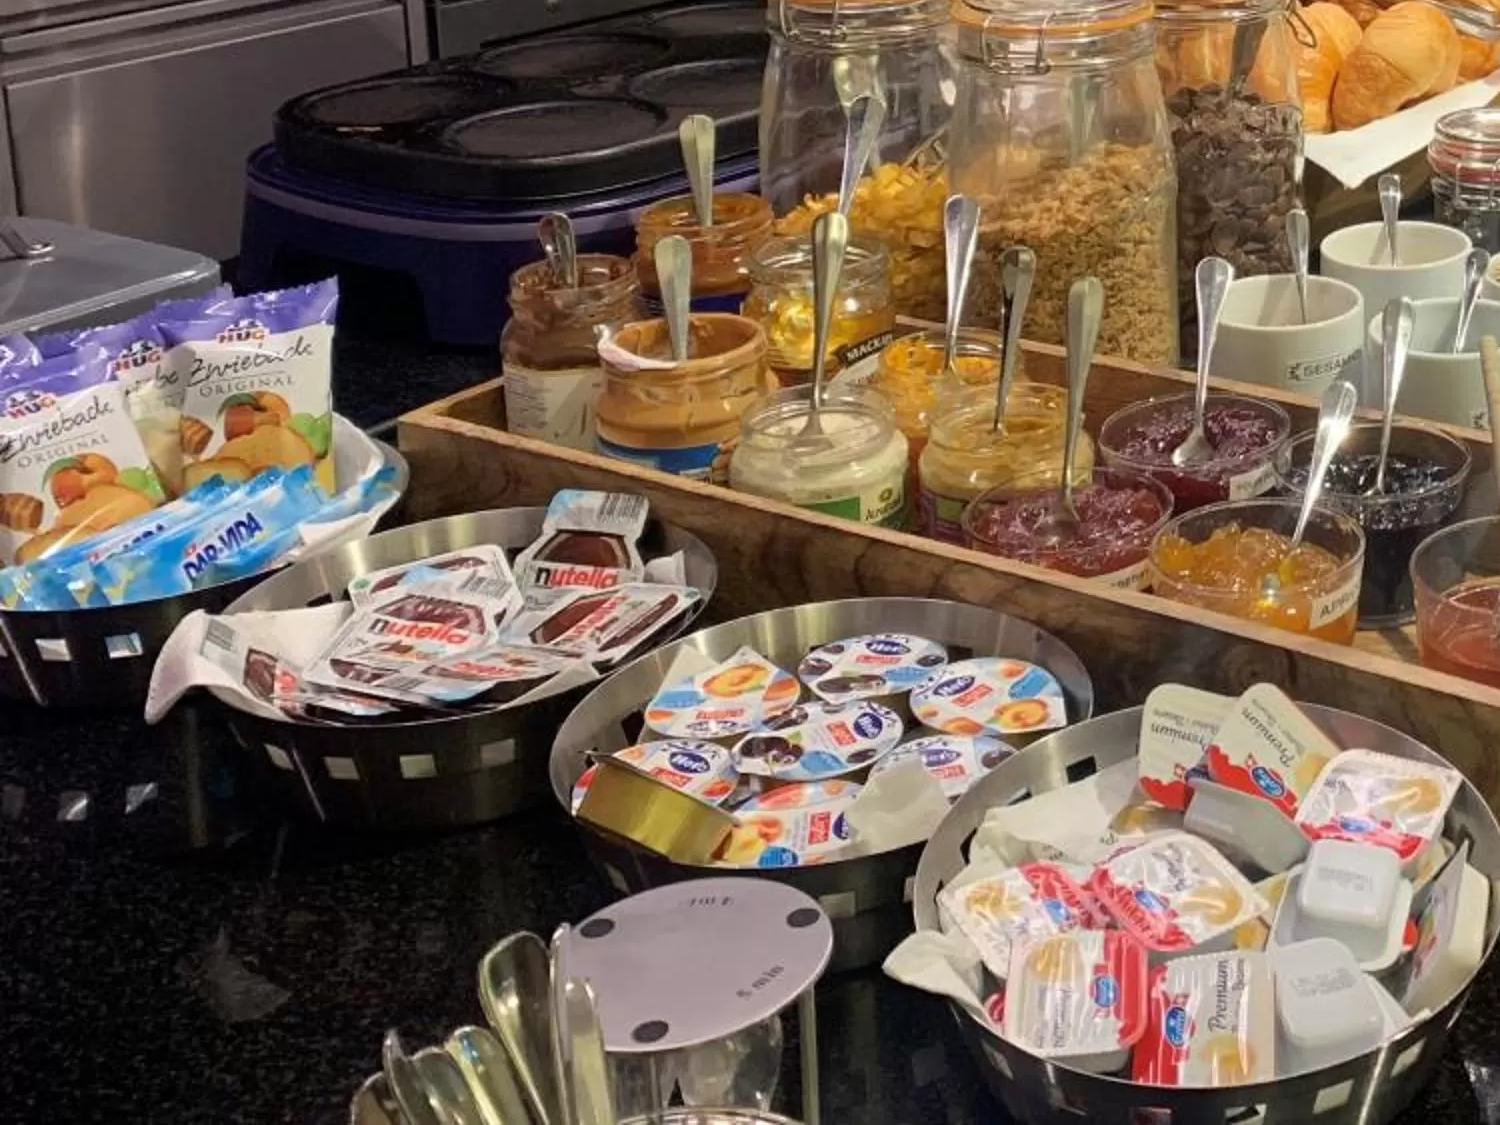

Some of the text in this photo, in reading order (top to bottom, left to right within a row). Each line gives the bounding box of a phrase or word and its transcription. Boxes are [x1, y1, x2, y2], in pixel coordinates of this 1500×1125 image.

[199, 374, 295, 398] ORIGINAL
[535, 566, 619, 588] nutella
[369, 618, 470, 645] nutella
